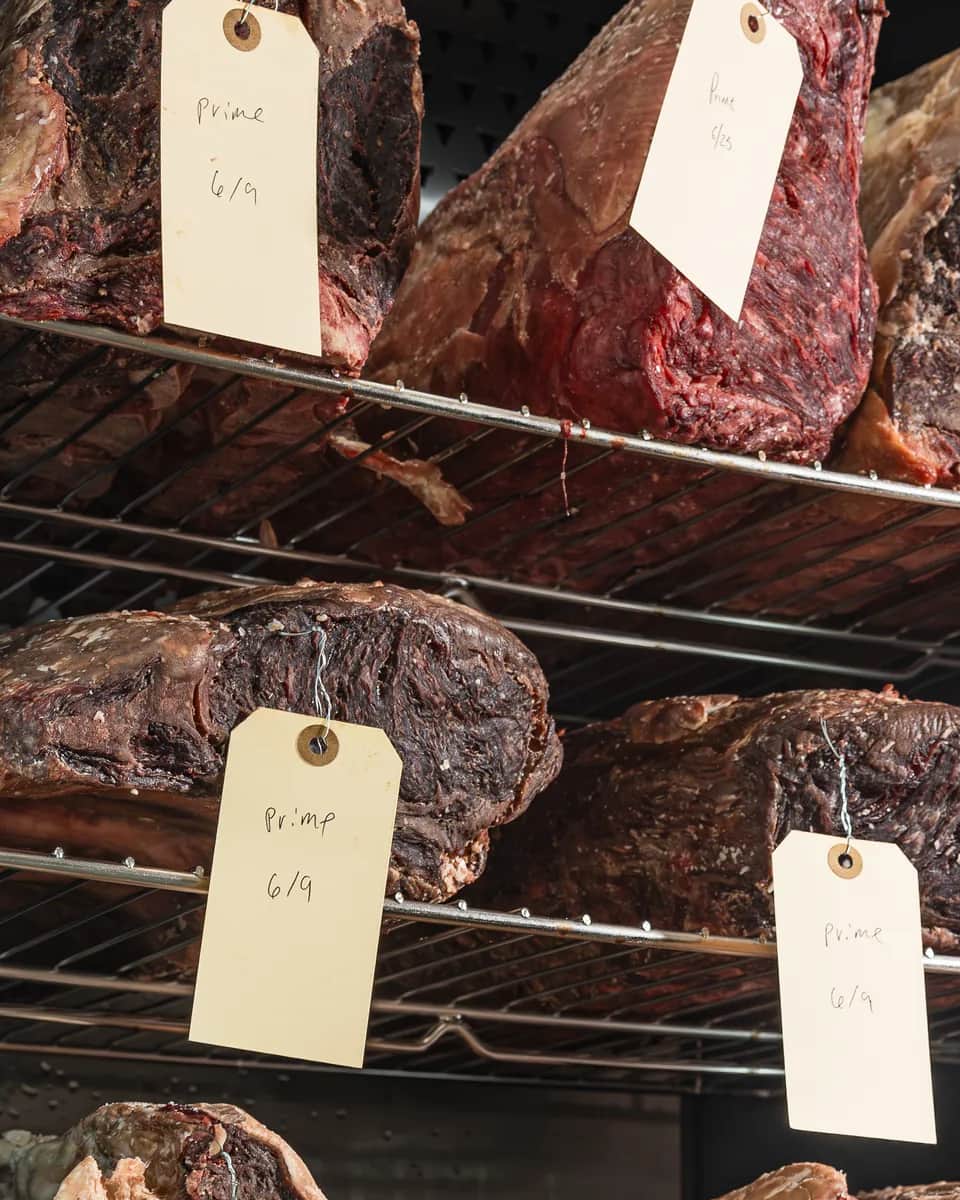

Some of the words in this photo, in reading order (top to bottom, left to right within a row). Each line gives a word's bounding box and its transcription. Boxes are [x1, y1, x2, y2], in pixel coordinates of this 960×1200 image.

[197, 97, 264, 125] Prime
[211, 170, 257, 205] 6/9
[267, 870, 312, 903] 6/9
[825, 922, 883, 947] Prime
[831, 984, 874, 1013] 6/9
